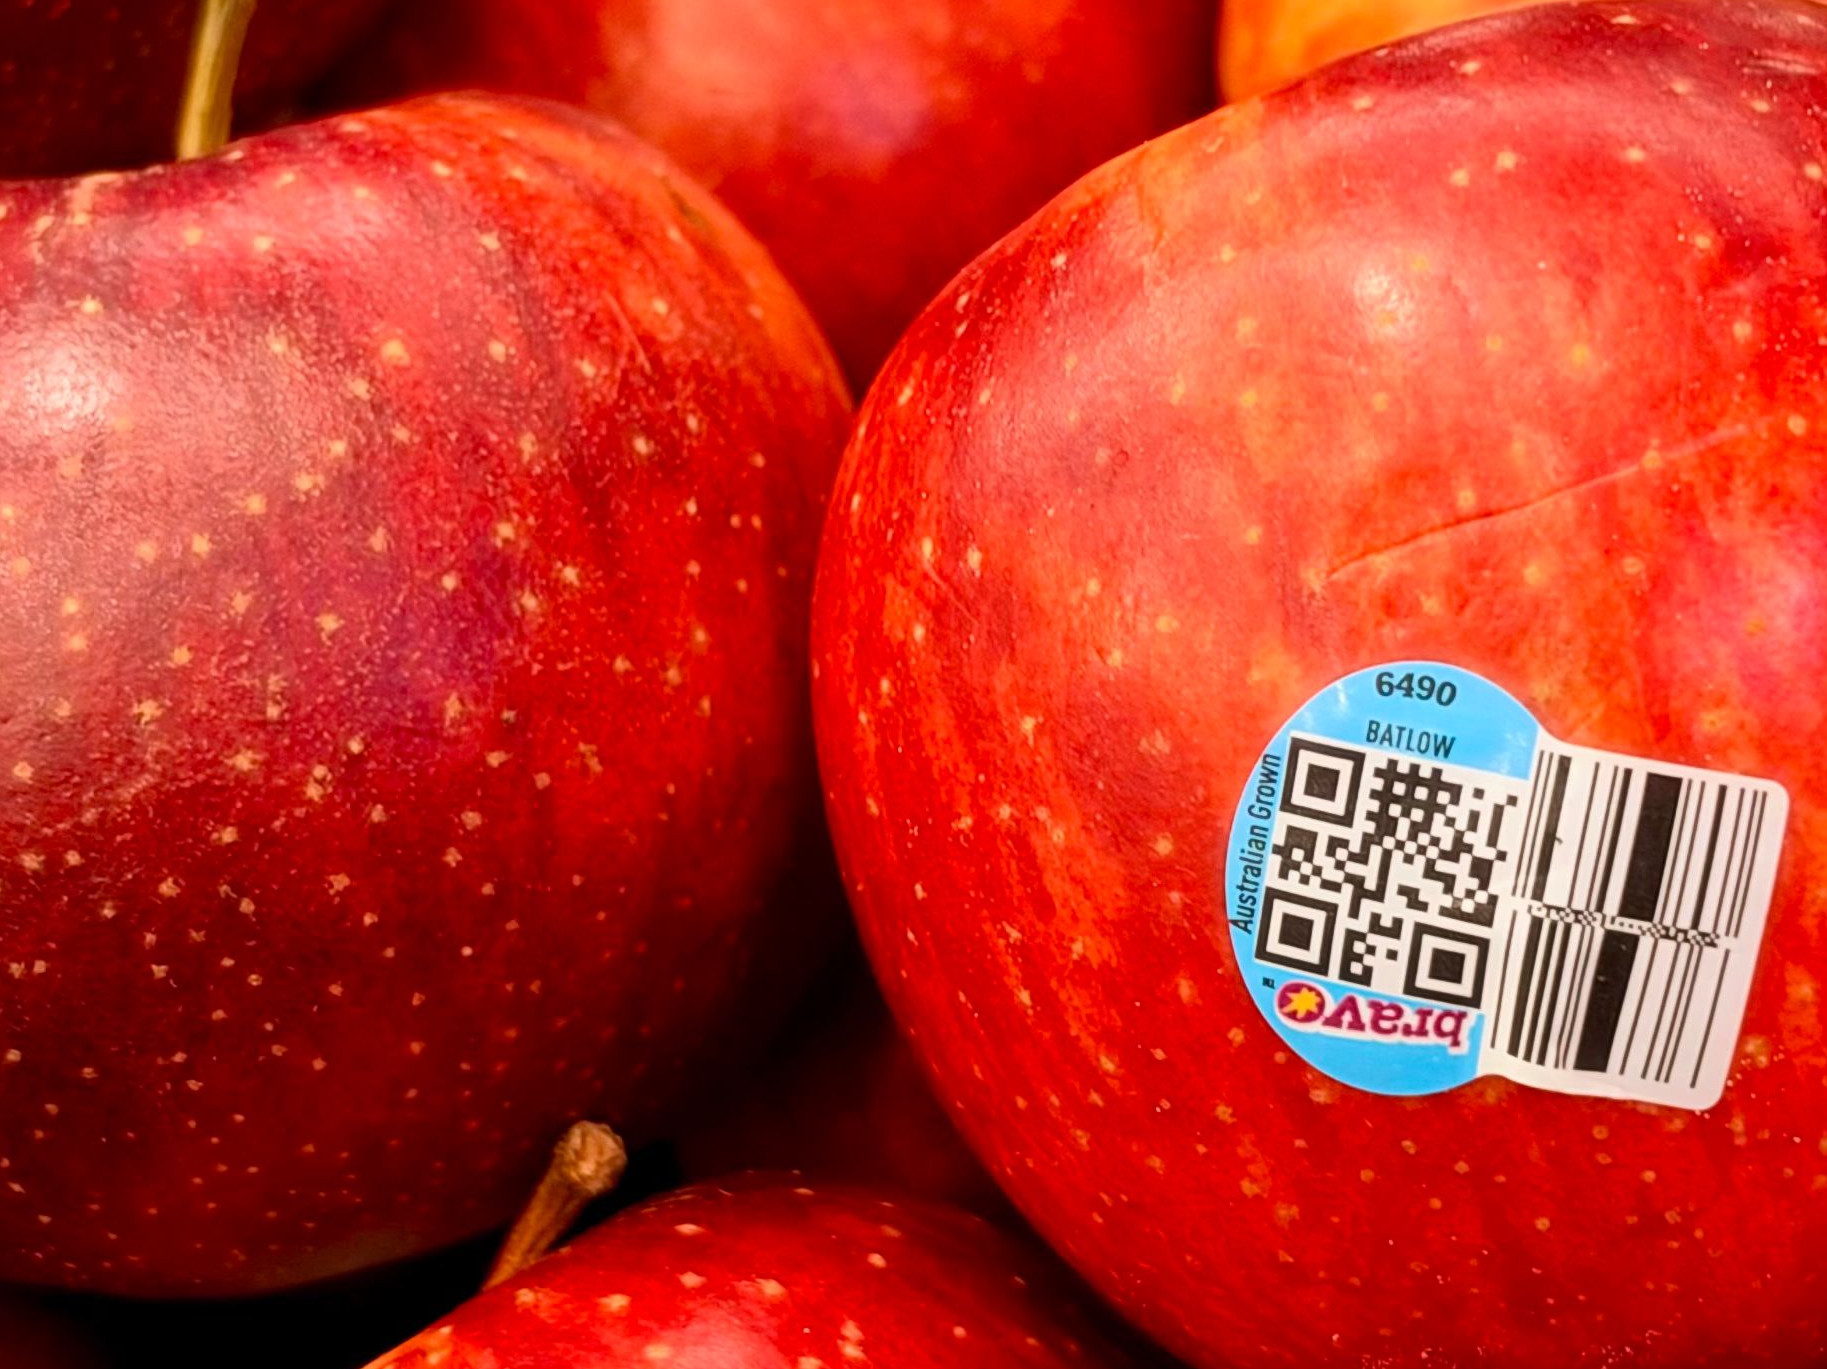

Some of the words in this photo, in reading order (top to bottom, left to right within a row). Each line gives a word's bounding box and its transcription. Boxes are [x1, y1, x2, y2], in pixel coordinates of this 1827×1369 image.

[1375, 670, 1457, 706] 6490
[1365, 719, 1456, 759] BATLOW
[1247, 753, 1282, 820] Grown
[1228, 835, 1267, 935] Australian
